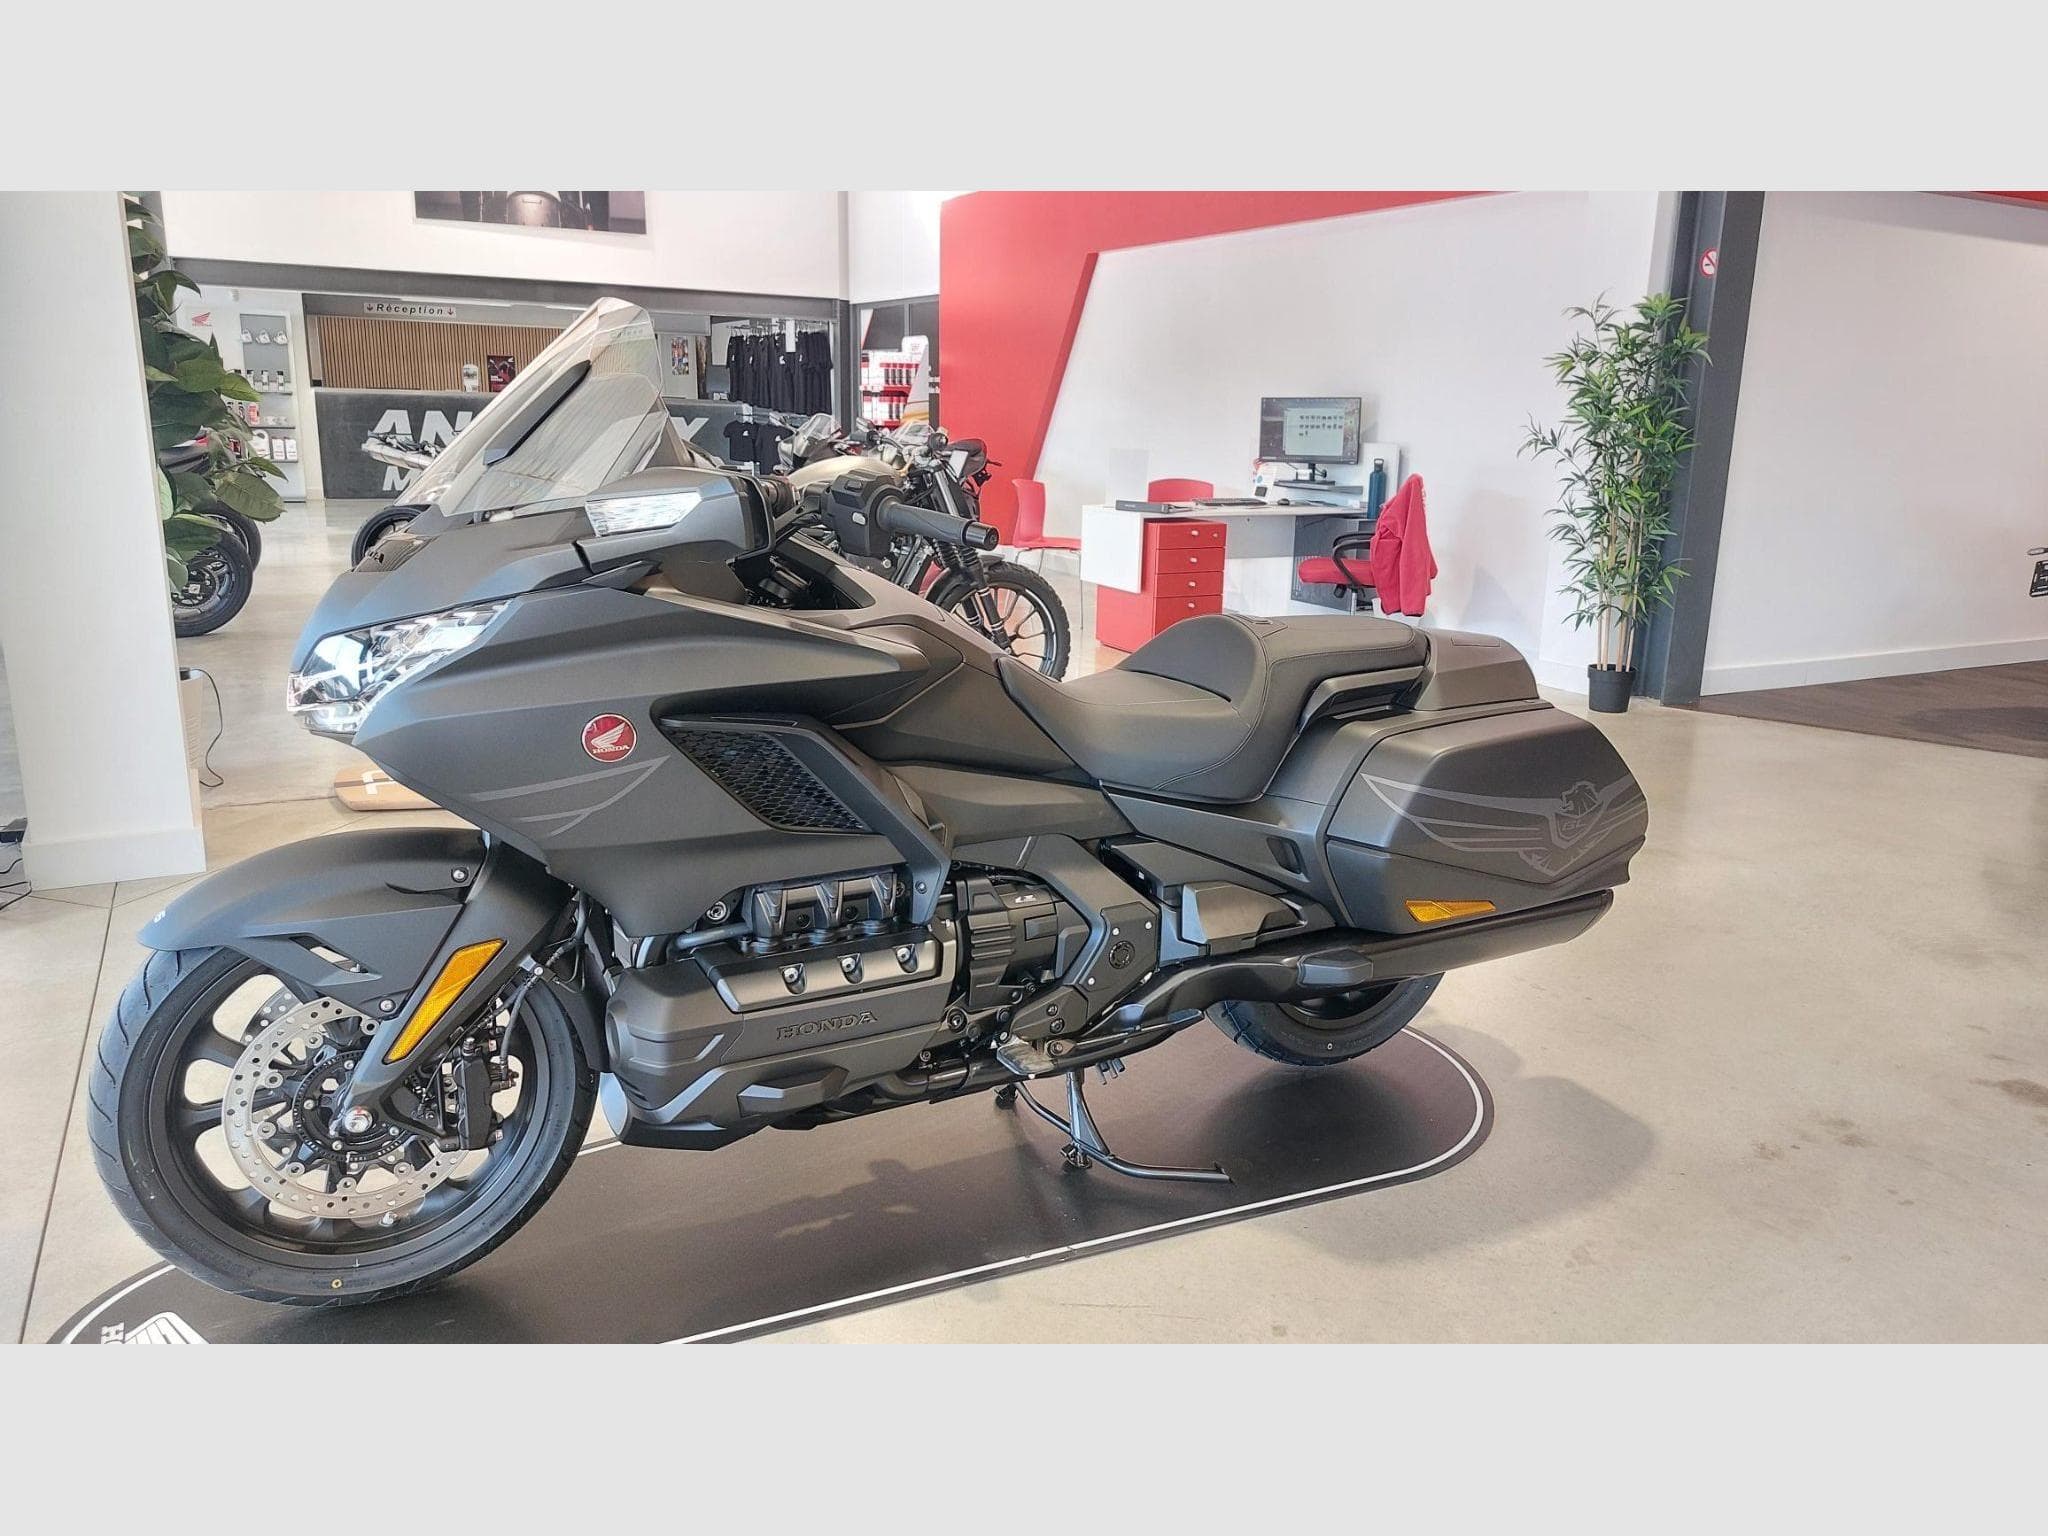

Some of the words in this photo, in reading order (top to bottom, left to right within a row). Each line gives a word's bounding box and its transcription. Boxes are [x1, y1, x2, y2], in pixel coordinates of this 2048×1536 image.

[376, 303, 443, 315] Réception
[592, 745, 631, 754] HONDA
[776, 1011, 878, 1040] HONDA
